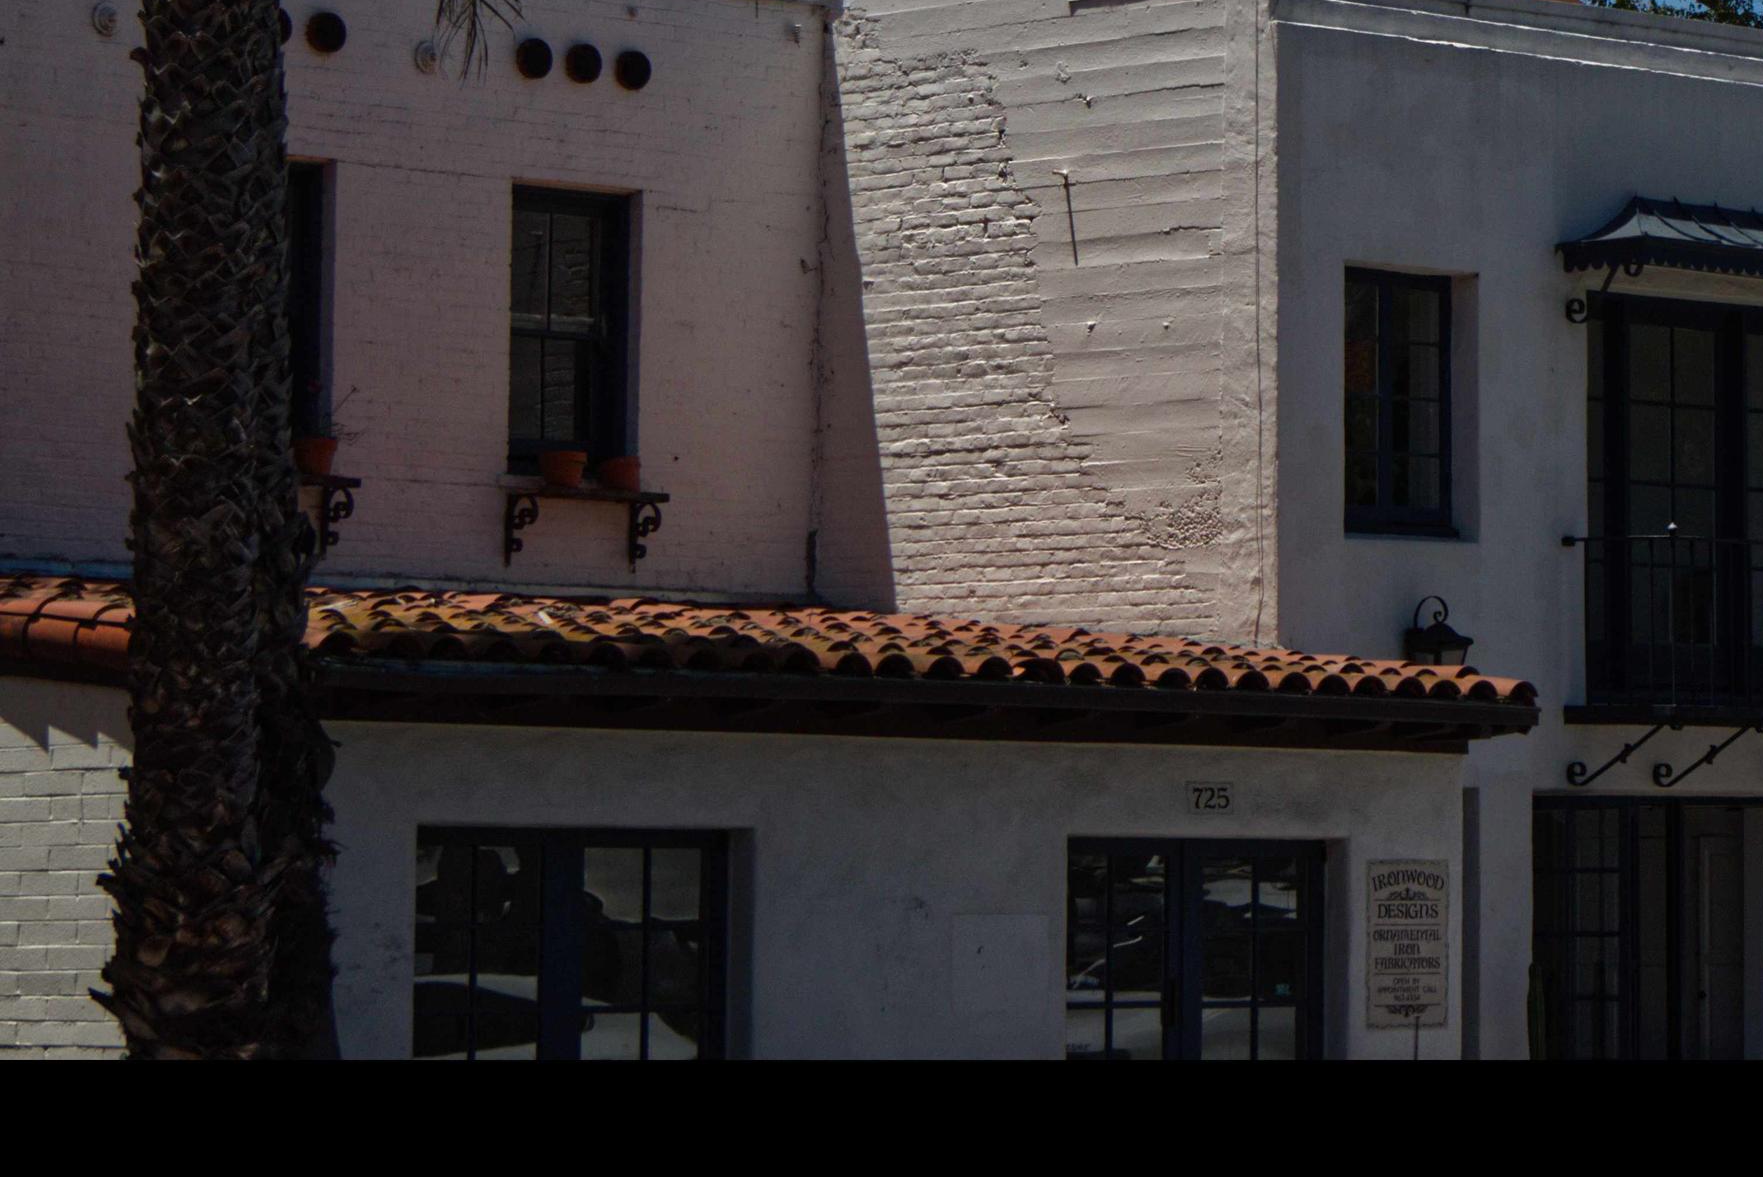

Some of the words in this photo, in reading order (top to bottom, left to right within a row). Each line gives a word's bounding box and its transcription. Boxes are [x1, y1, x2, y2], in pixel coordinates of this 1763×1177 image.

[1193, 787, 1230, 809] 725
[1372, 869, 1444, 892] IRONWOOD
[1378, 904, 1439, 919] DESIGNS
[1372, 928, 1441, 942] ORNAMENTAL
[1394, 943, 1420, 956] IRON
[1375, 957, 1440, 969] FABRICATORS
